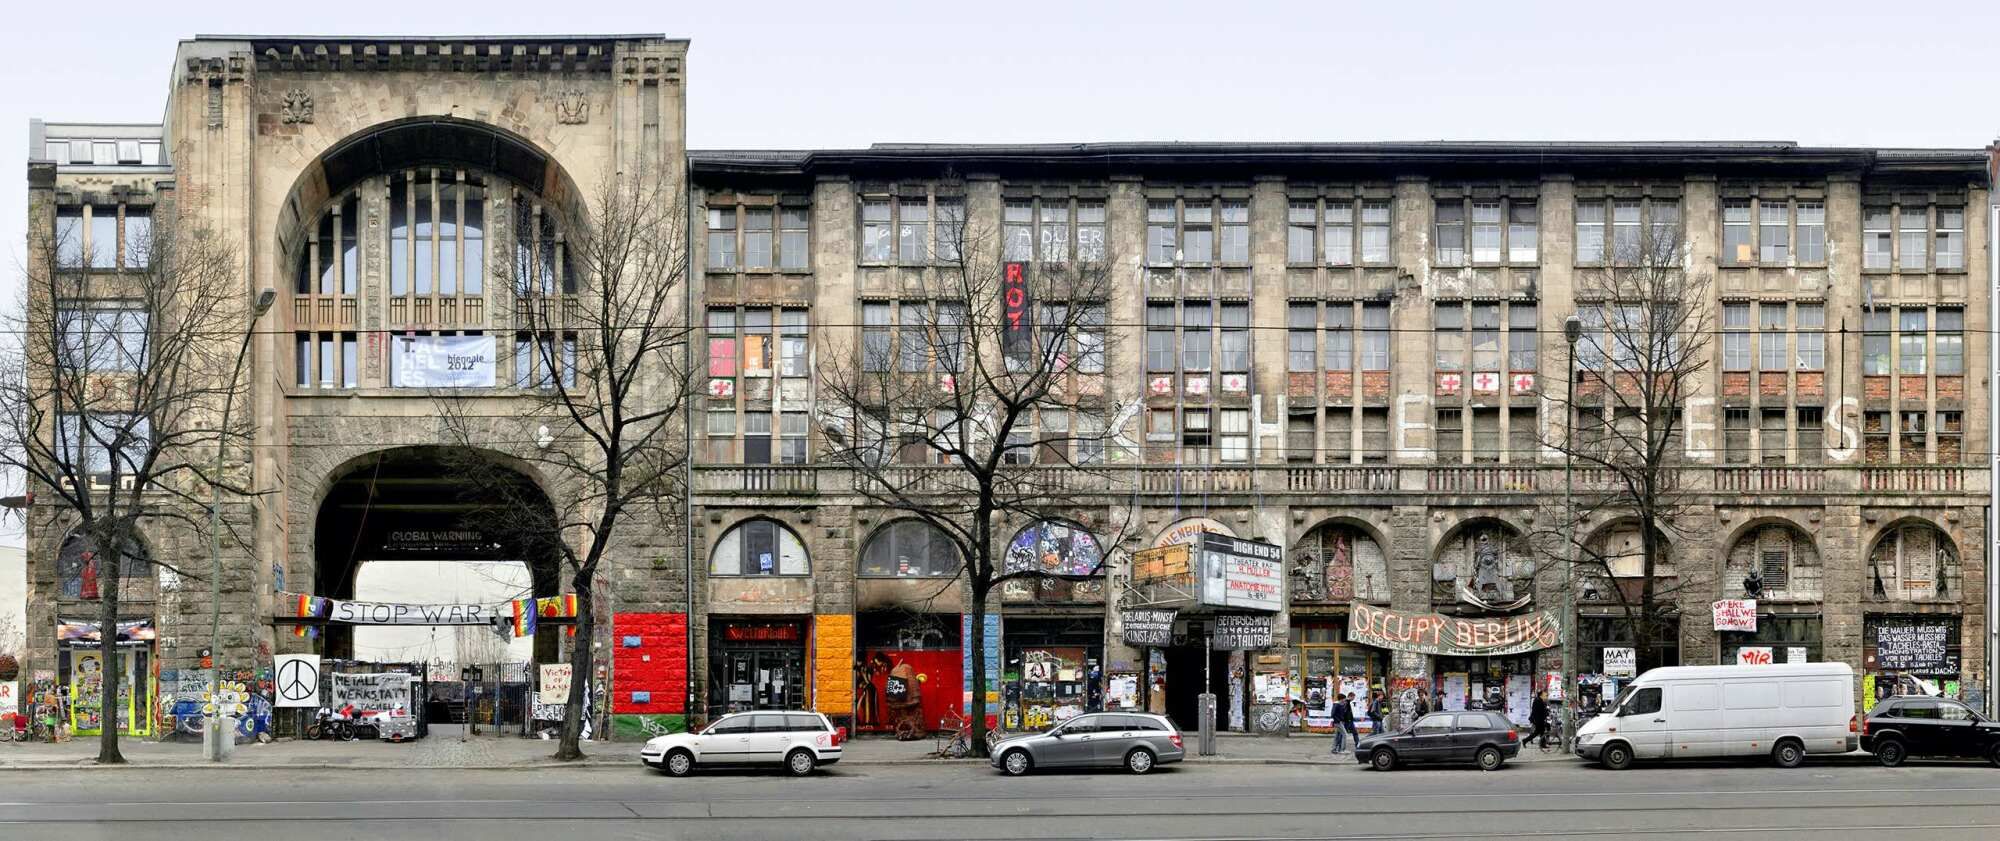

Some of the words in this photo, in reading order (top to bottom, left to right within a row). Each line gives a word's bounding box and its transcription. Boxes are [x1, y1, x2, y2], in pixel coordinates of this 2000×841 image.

[447, 361, 474, 370] 2012
[1233, 541, 1253, 555] HIGH
[1254, 545, 1269, 558] END
[1270, 548, 1280, 560] 54
[339, 602, 409, 623] STOP
[419, 604, 482, 624] WAR
[1354, 604, 1446, 645] OCCUPY
[1456, 617, 1541, 648] BERLIN
[334, 675, 380, 687] METALL
[337, 688, 407, 700] WERKSTATT
